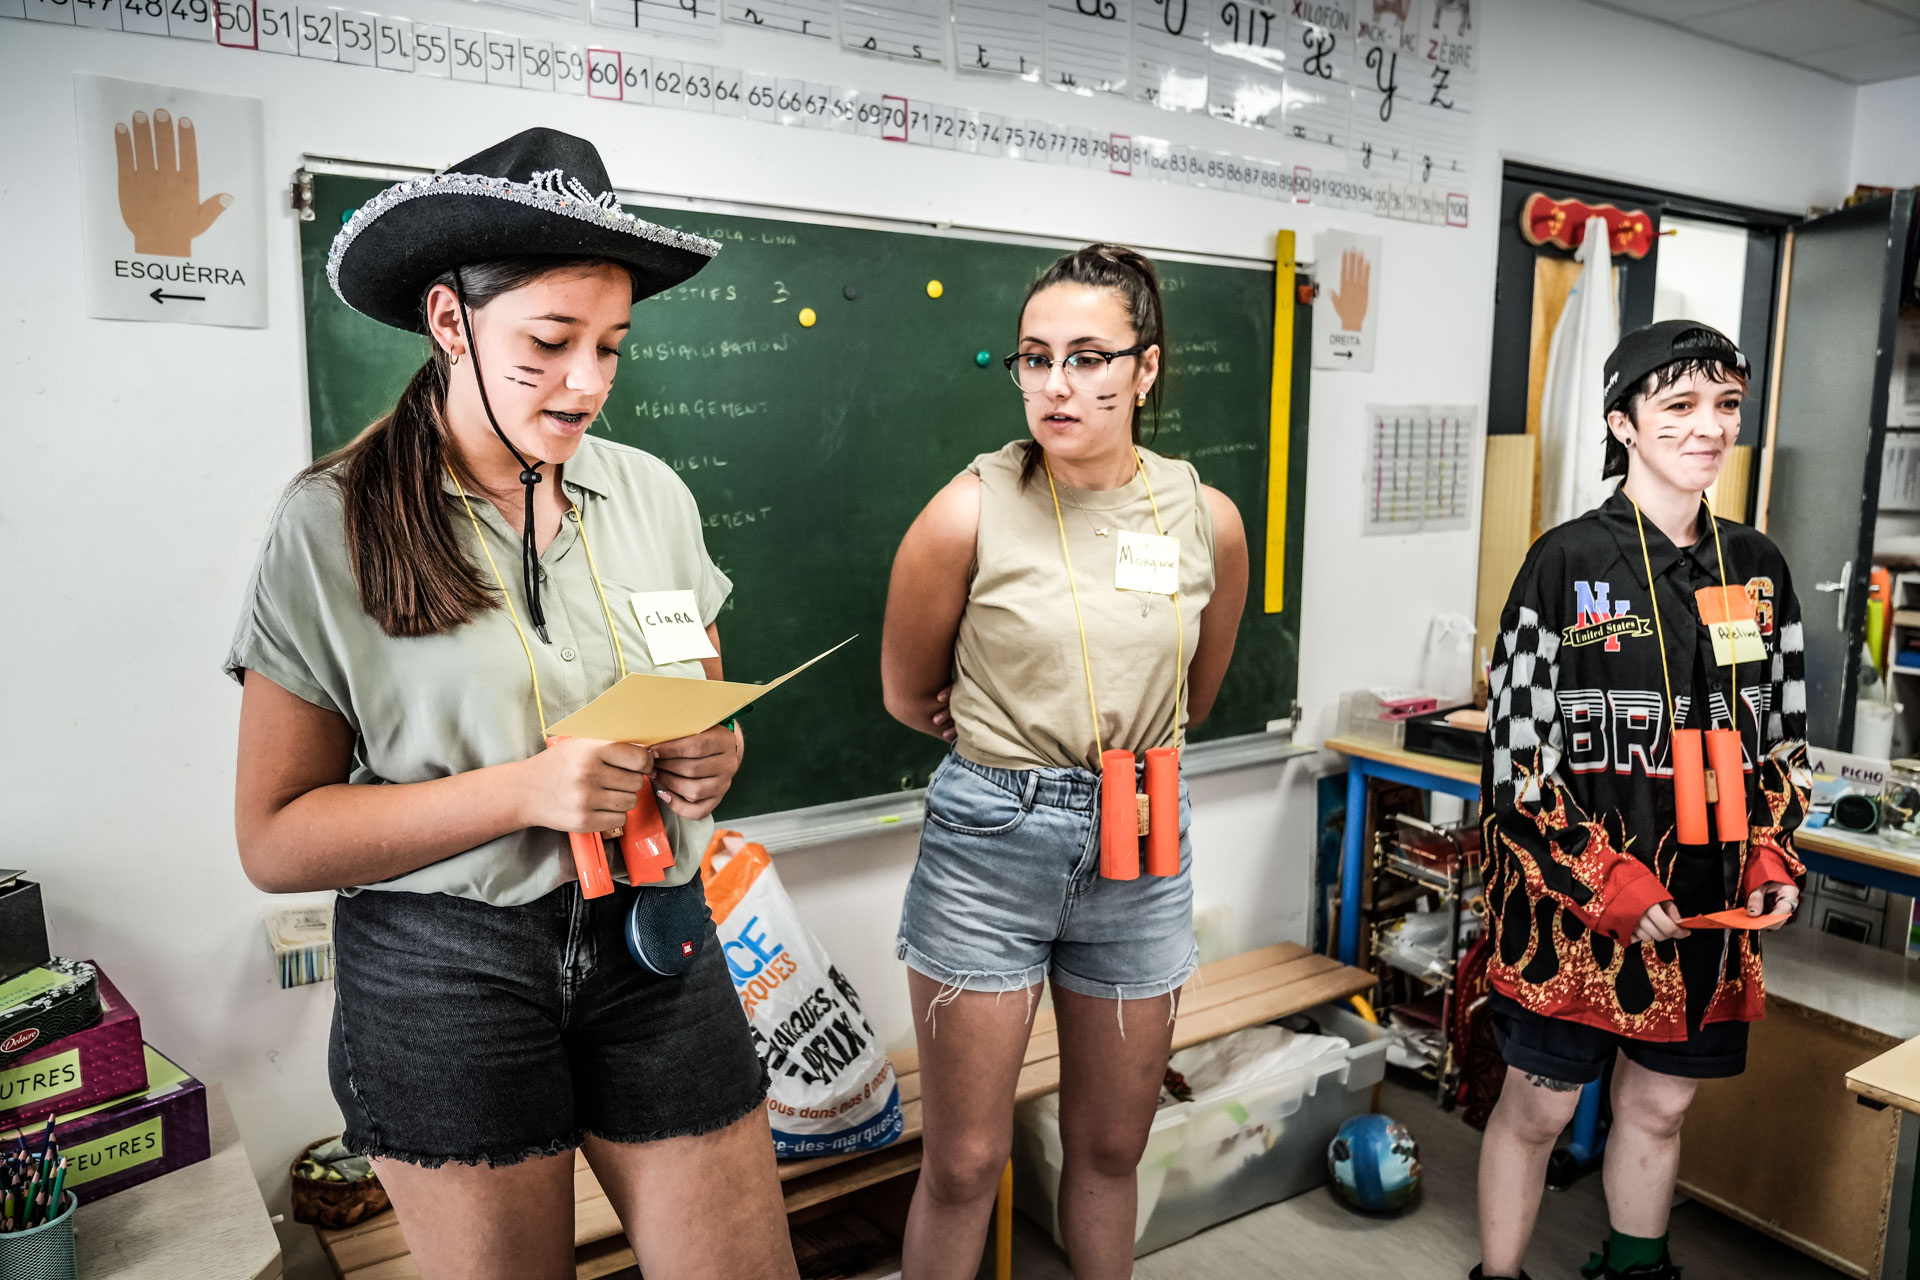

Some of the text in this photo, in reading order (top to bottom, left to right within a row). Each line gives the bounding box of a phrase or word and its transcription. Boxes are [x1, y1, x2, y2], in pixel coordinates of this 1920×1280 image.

[170, 0, 209, 23] 49
[218, 2, 251, 33] 50
[262, 8, 291, 38] 51
[303, 15, 332, 45] 52
[342, 19, 372, 51] 53
[415, 34, 446, 63] 55
[454, 38, 483, 68] 56
[489, 42, 516, 72] 57
[523, 46, 551, 77] 58
[554, 50, 584, 81] 59
[589, 62, 619, 85] 60
[624, 66, 649, 89] 61
[655, 71, 681, 94] 62
[685, 75, 711, 98] 63
[715, 80, 740, 102] 64
[749, 86, 774, 108] 65
[777, 89, 802, 112] 66
[805, 94, 828, 116] 67
[857, 102, 881, 125] 69
[883, 107, 906, 128] 70
[910, 111, 929, 132] 71
[934, 114, 954, 137] 72
[958, 119, 978, 141] 73
[981, 123, 1000, 144] 74
[1005, 127, 1025, 148] 75
[1028, 130, 1047, 151] 76
[1049, 134, 1066, 153] 77
[1071, 137, 1088, 157] 78
[1091, 139, 1109, 159] 79
[1110, 145, 1130, 164] 80
[1132, 147, 1148, 166] 81
[1169, 154, 1187, 174] 83
[1188, 156, 1206, 175] 84
[1207, 160, 1225, 179] 85
[1226, 163, 1242, 182] 86
[1243, 165, 1259, 185] 87
[1261, 169, 1276, 188] 88
[1278, 172, 1293, 191] 89
[1294, 176, 1310, 193] 90
[1311, 177, 1327, 196] 91
[1328, 181, 1343, 198] 92
[1343, 183, 1358, 201] 93
[1358, 185, 1373, 202] 94
[1449, 202, 1467, 218] 100
[114, 259, 246, 286] ESQUÈRRA
[1575, 621, 1636, 643] United States
[799, 1106, 838, 1119] dans
